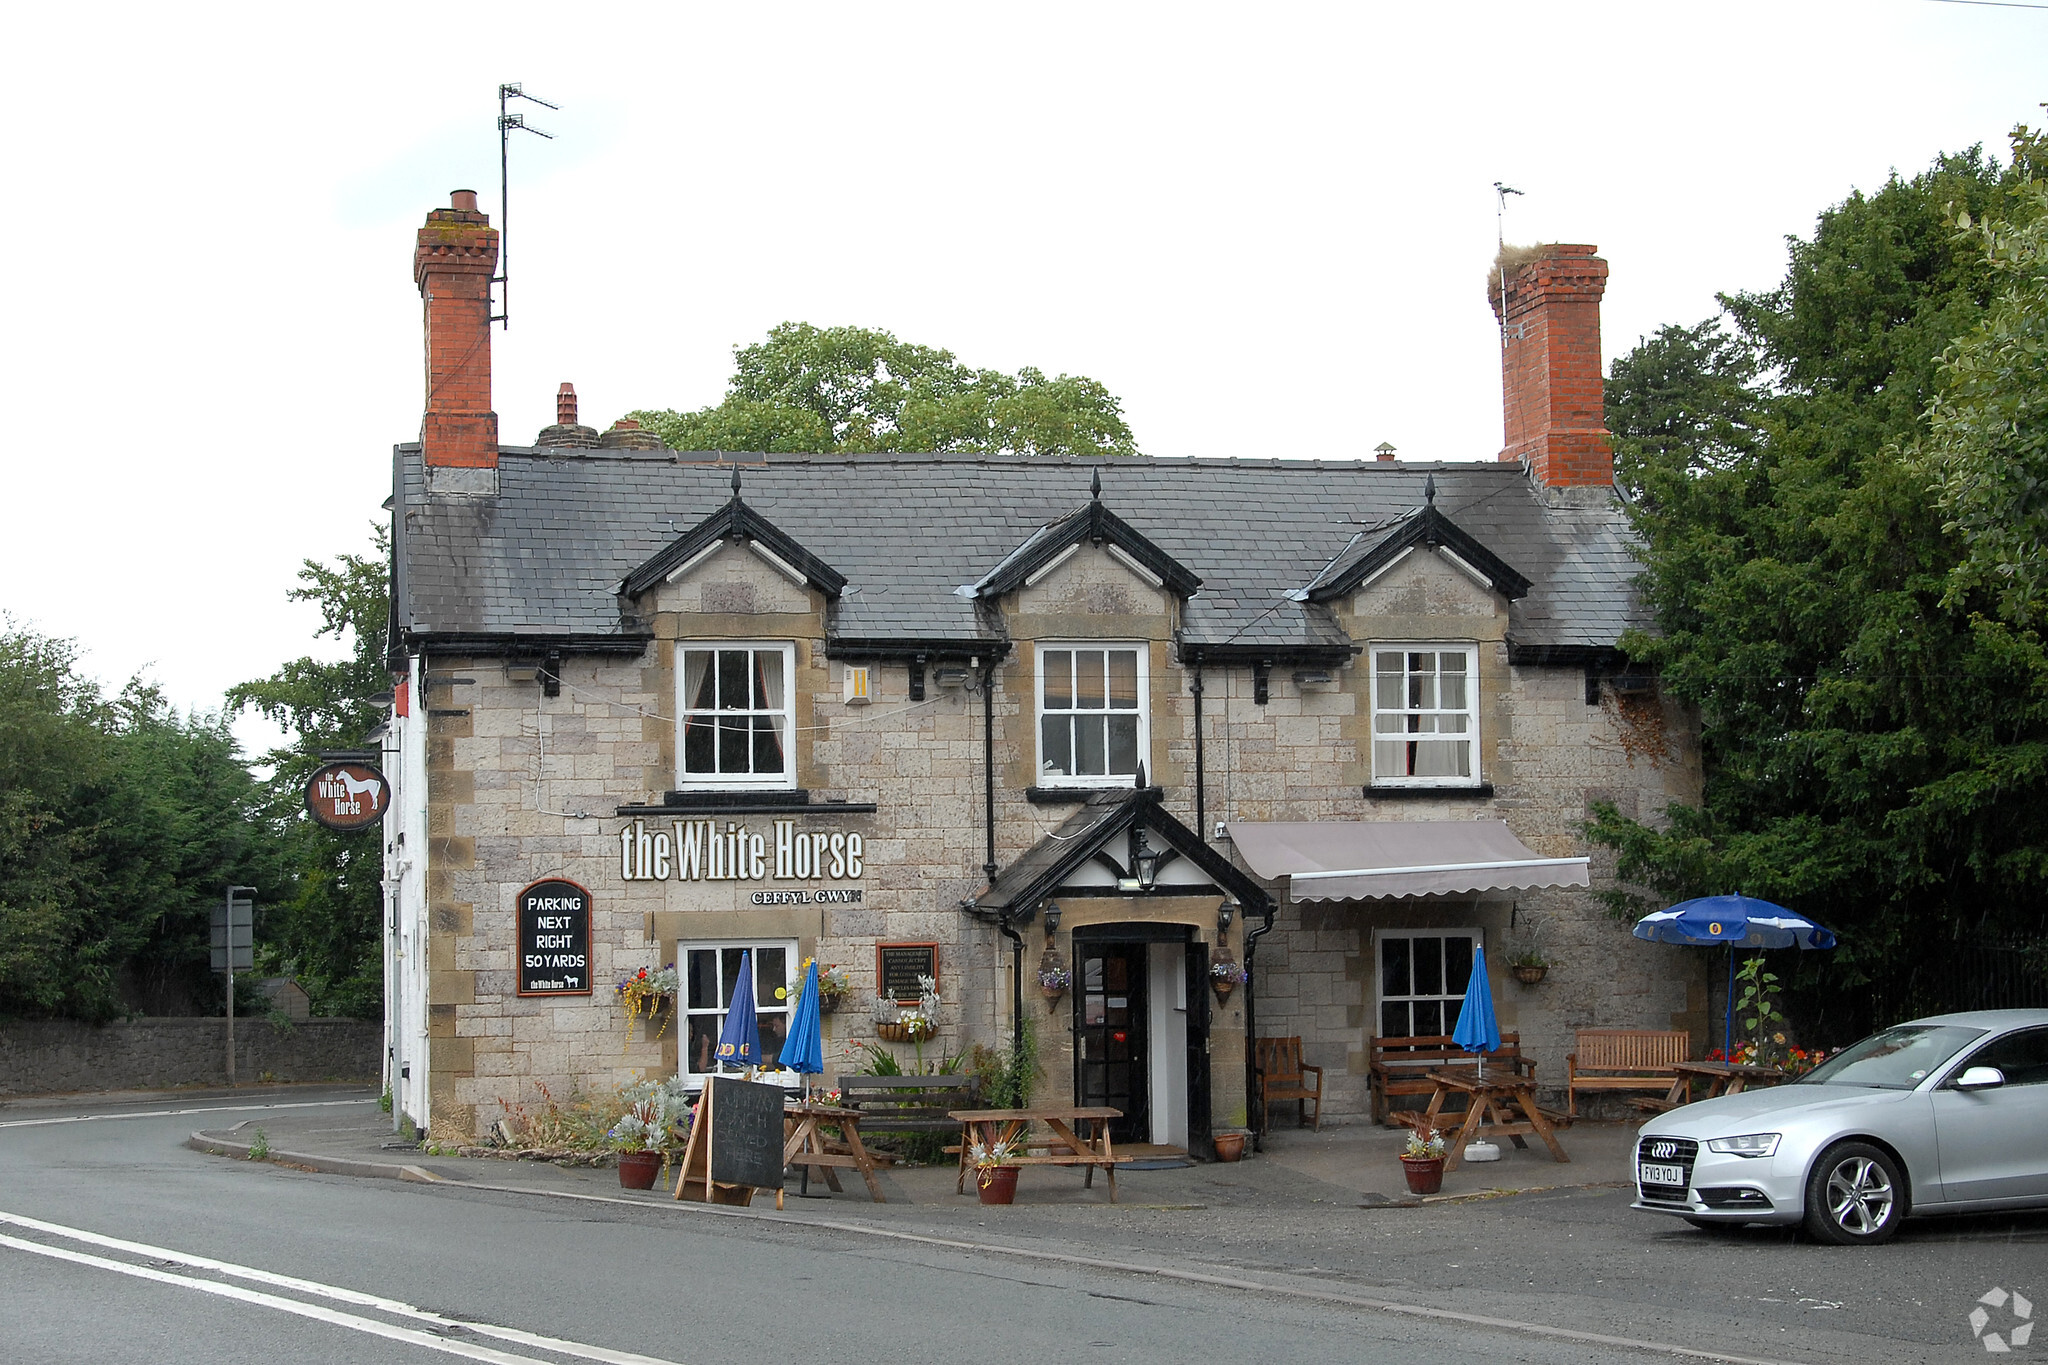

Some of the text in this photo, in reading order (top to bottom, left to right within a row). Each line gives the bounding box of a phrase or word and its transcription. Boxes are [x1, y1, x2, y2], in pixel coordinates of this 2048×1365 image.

[318, 781, 345, 798] White
[334, 798, 361, 816] Horse
[620, 818, 863, 882] the White Horse
[527, 897, 581, 911] PARKING
[751, 890, 811, 905] CEFFYL
[537, 916, 572, 930] NEXT
[536, 935, 573, 949] RIGHT
[525, 954, 586, 968] 50 YARDS
[1661, 1167, 1678, 1182] YOJ
